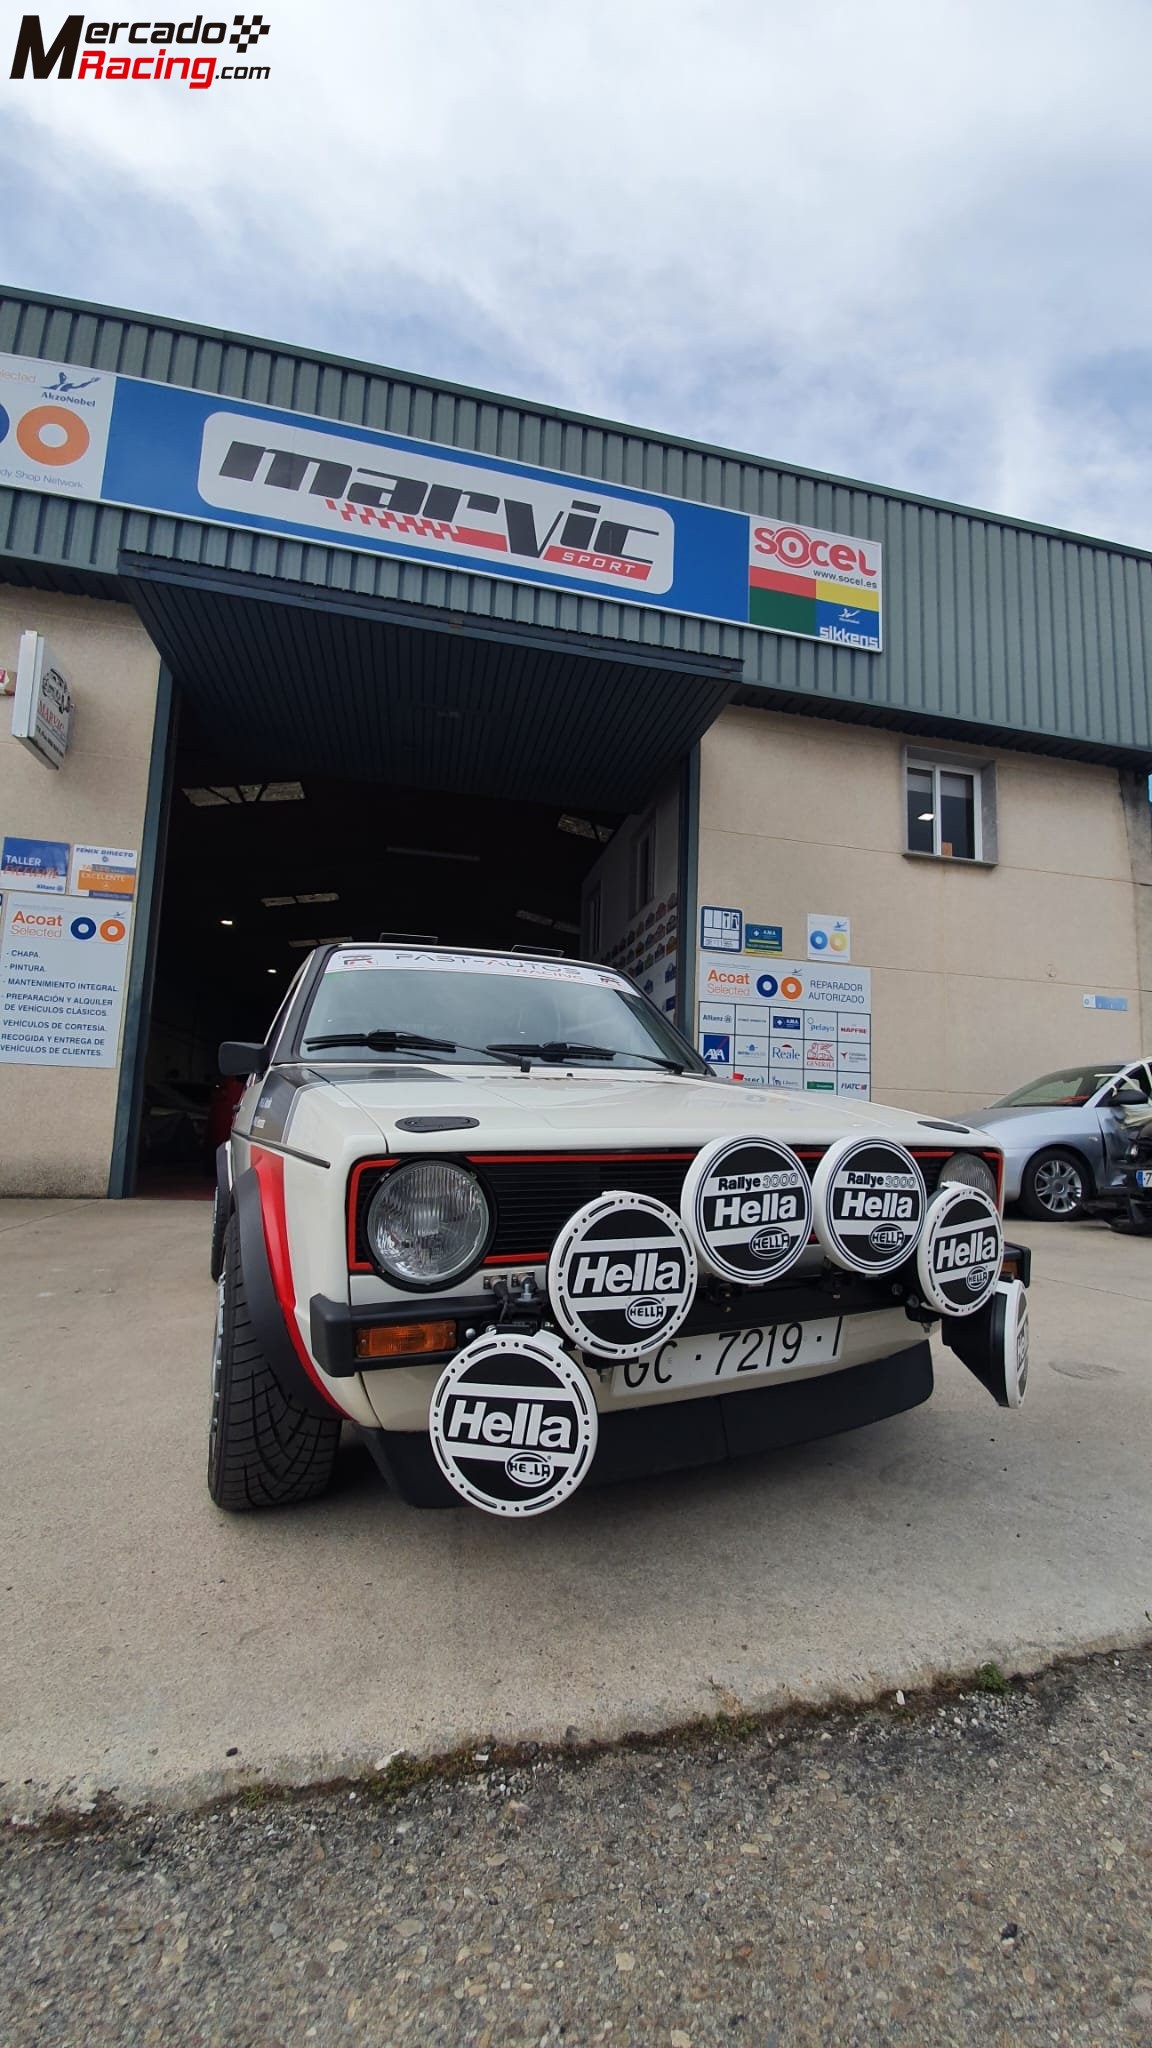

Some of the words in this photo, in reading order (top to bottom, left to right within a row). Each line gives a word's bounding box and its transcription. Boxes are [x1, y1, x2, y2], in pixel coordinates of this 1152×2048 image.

[41, 391, 96, 408] AkzoNobel
[15, 469, 41, 483] Shop
[43, 474, 83, 489] Network
[562, 551, 636, 575] SPORT
[813, 569, 878, 589] www.socel.es
[819, 626, 879, 648] sikkens
[5, 854, 42, 867] TALLER
[101, 850, 134, 858] DIRECTO
[12, 911, 63, 927] Acoat
[10, 924, 62, 938] Selected
[8, 978, 76, 990] MANTENIMIENTO
[707, 969, 750, 985] Acoat
[706, 983, 750, 997] Selected
[810, 979, 863, 992] REPARADOR
[73, 998, 113, 1006] ALQUILER
[808, 991, 865, 1005] AUTORIZADO
[4, 1003, 16, 1011] DE
[51, 1022, 63, 1030] DE
[810, 1023, 835, 1033] pelayo
[1, 1033, 45, 1042] RECOGIDA
[47, 1035, 53, 1043] Y
[53, 1037, 92, 1046] ENTREGA
[94, 1038, 105, 1046] DE
[48, 1046, 60, 1055] DE
[703, 1048, 726, 1061] AXA
[772, 1046, 801, 1062] Reale
[718, 1176, 761, 1192] Rallye
[762, 1172, 799, 1189] 3000
[846, 1172, 884, 1187] Rallye
[713, 1192, 798, 1227] Hella
[840, 1190, 913, 1218] Hella
[752, 1233, 790, 1250] HELLA
[871, 1231, 905, 1245] HELLA
[936, 1231, 996, 1270] Hella
[572, 1252, 681, 1294] Hella
[968, 1271, 988, 1284] HELLA
[629, 1305, 664, 1317] HELLA
[715, 1322, 804, 1376] 7219
[447, 1399, 572, 1449] Hella
